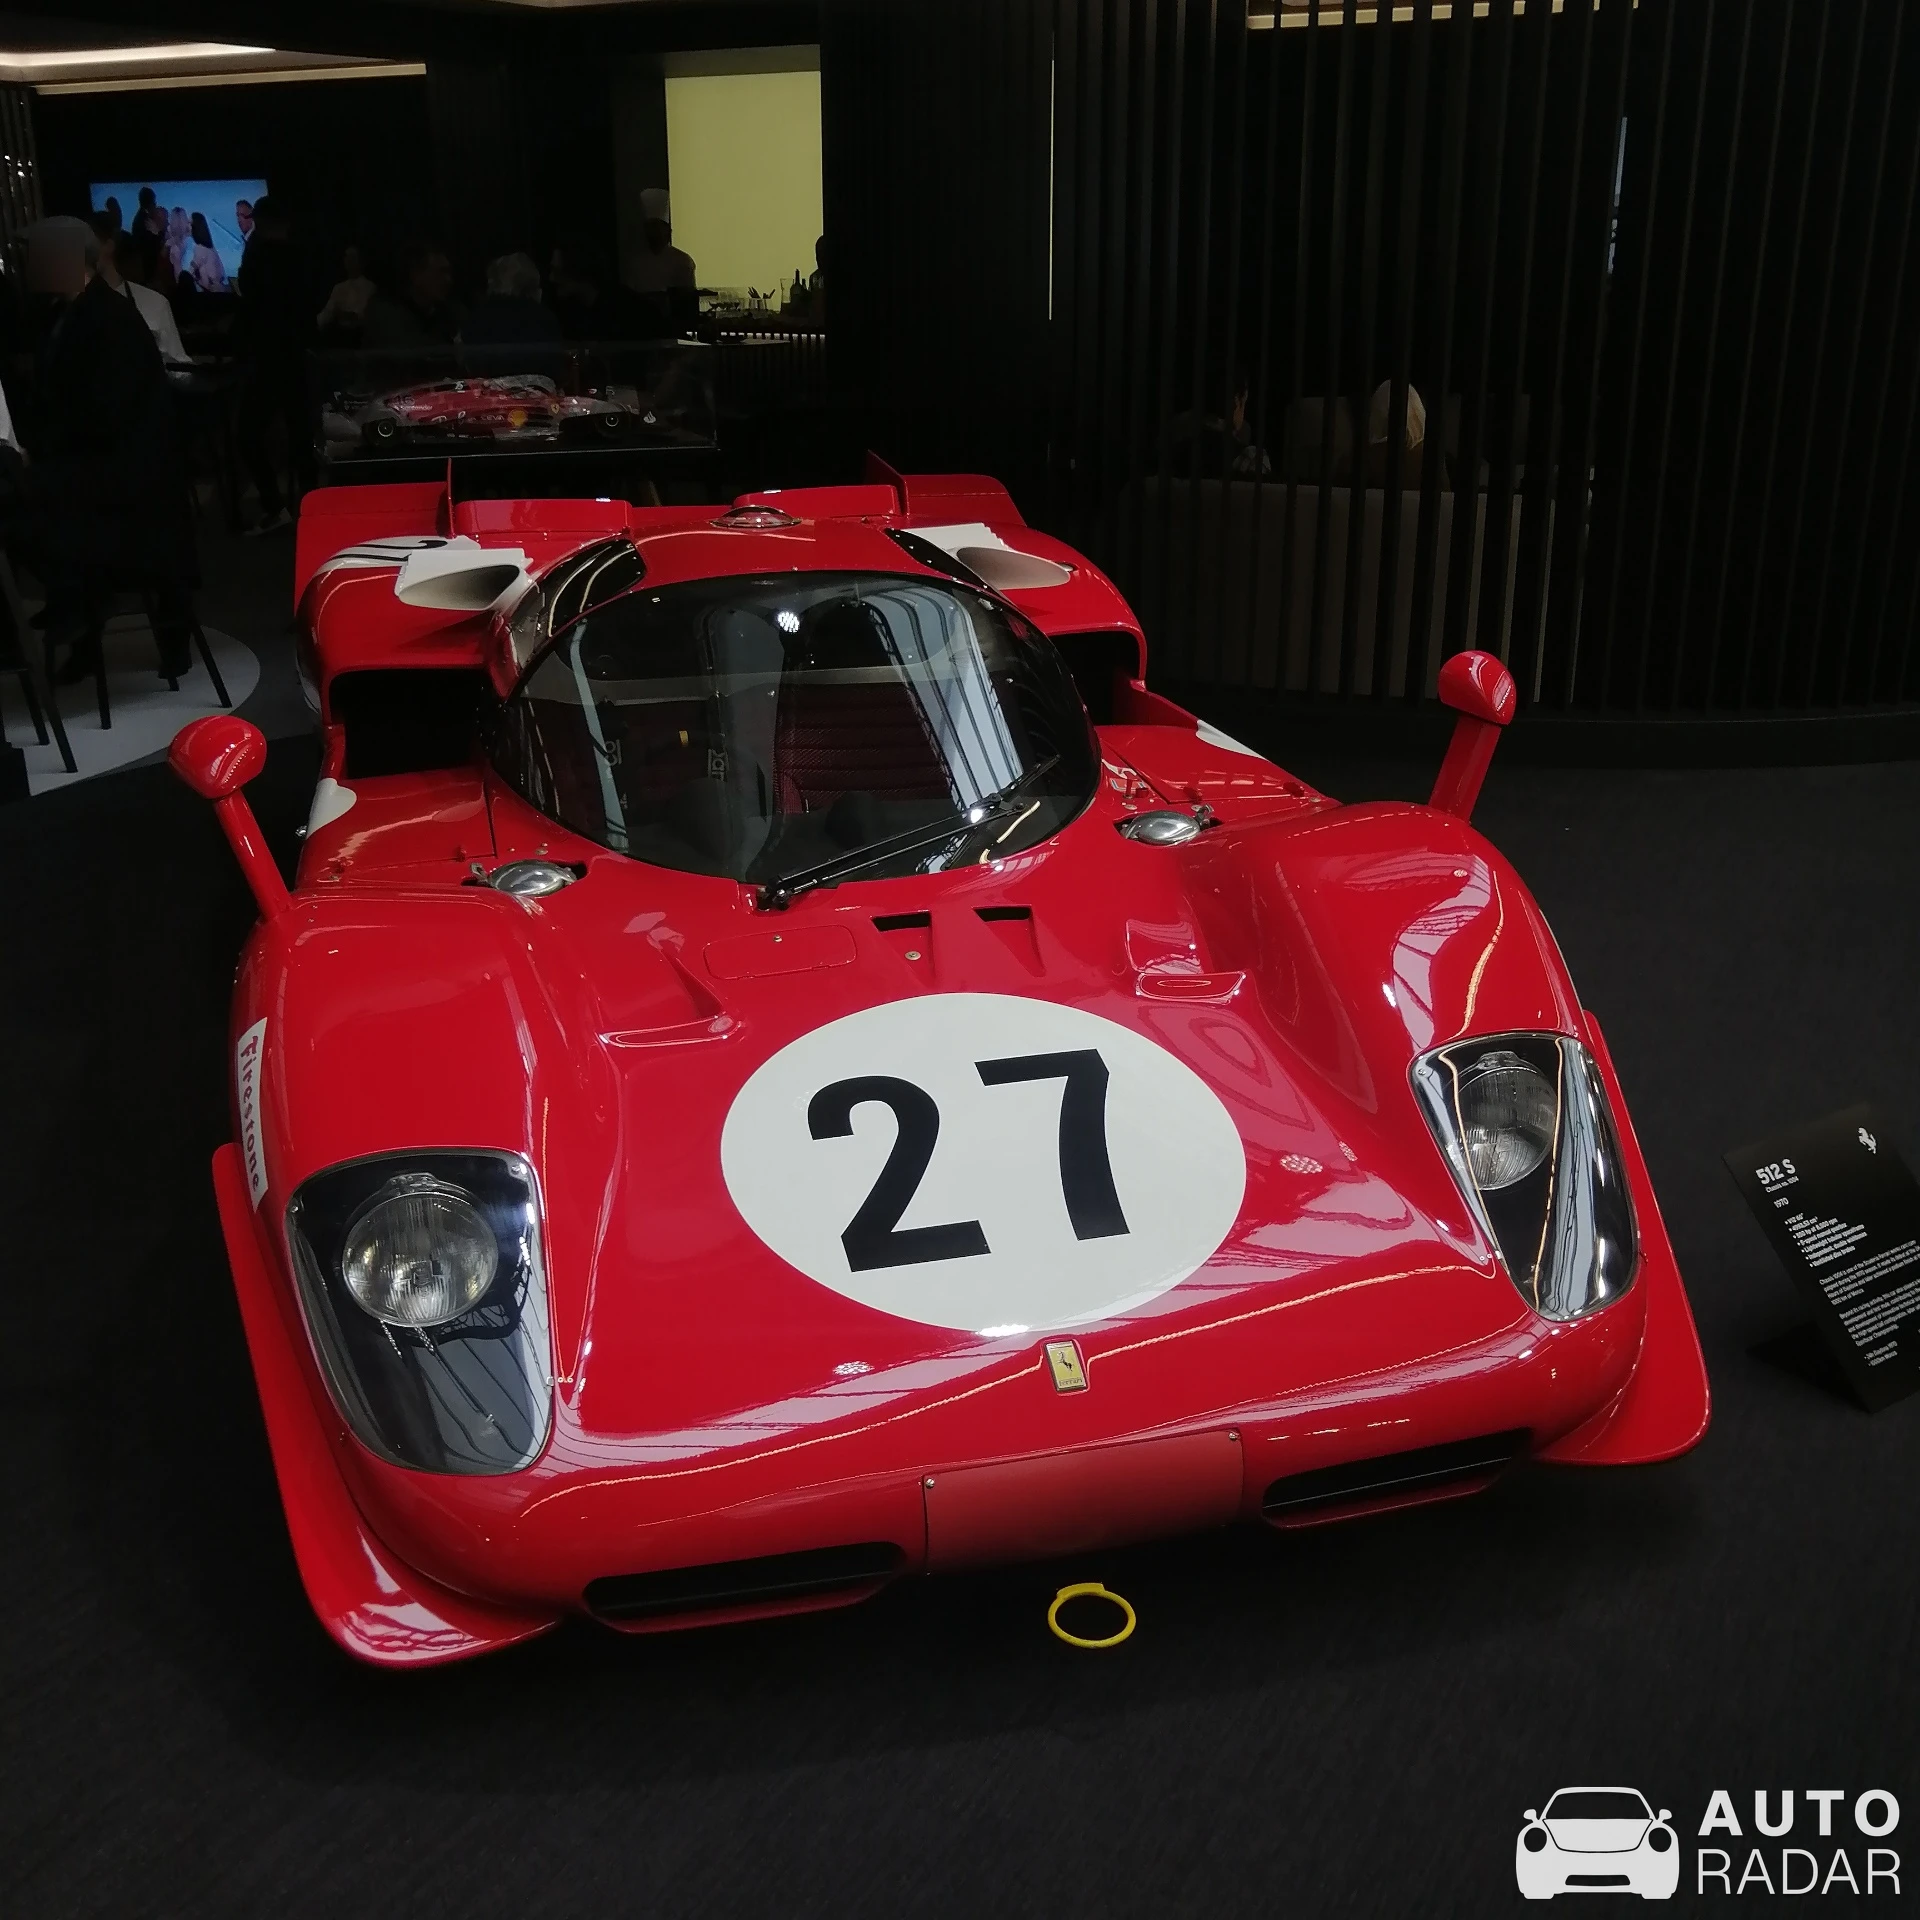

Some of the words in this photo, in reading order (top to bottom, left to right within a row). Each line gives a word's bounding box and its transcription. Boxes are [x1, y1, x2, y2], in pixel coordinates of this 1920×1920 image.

[240, 1036, 260, 1192] Firestone
[807, 1048, 1131, 1273] 27
[1755, 1163, 1785, 1185] 512
[1782, 1158, 1796, 1175] S
[1773, 1197, 1789, 1209] 1970
